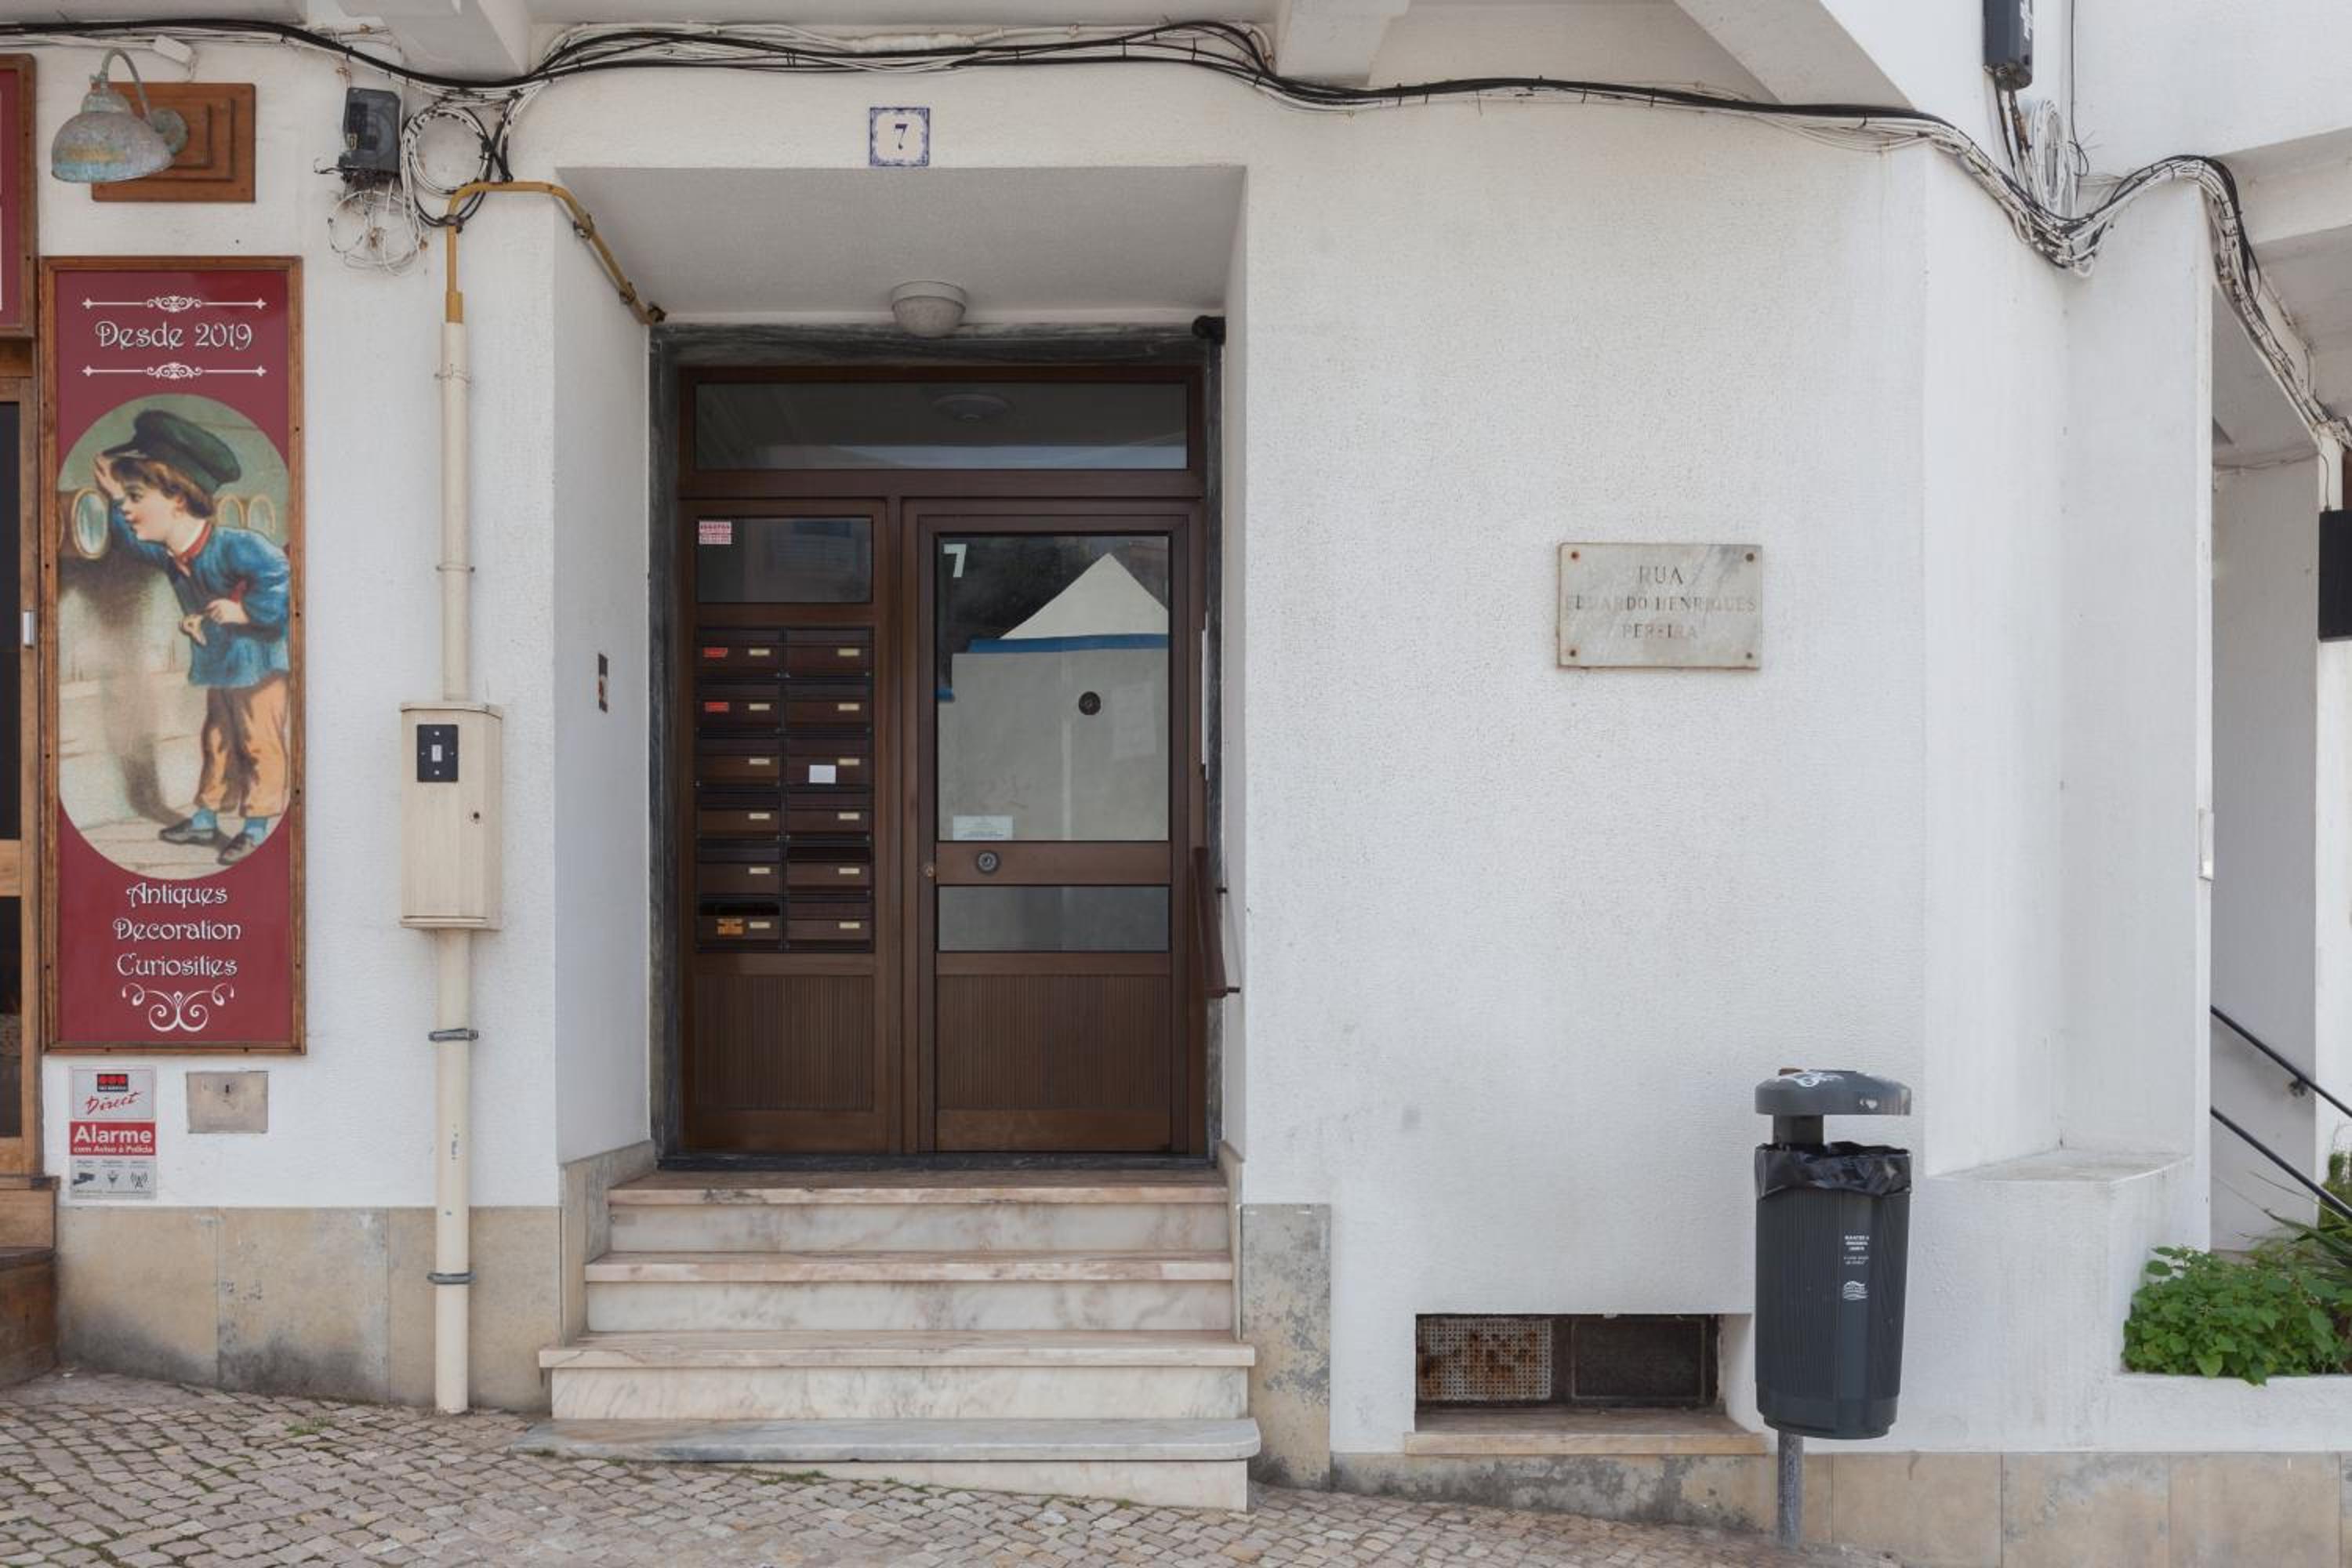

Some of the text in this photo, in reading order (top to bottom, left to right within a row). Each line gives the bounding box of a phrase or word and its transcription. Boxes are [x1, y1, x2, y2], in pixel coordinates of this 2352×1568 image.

[895, 123, 908, 151] 7
[95, 321, 252, 350] Desde 2019
[943, 543, 967, 577] 7
[1639, 564, 1683, 585] RUA
[125, 882, 227, 909] Antiques
[113, 917, 241, 941] Decoration
[117, 953, 238, 977] Curiosities
[85, 1091, 141, 1115] Direct
[74, 1123, 152, 1144] Alarme
